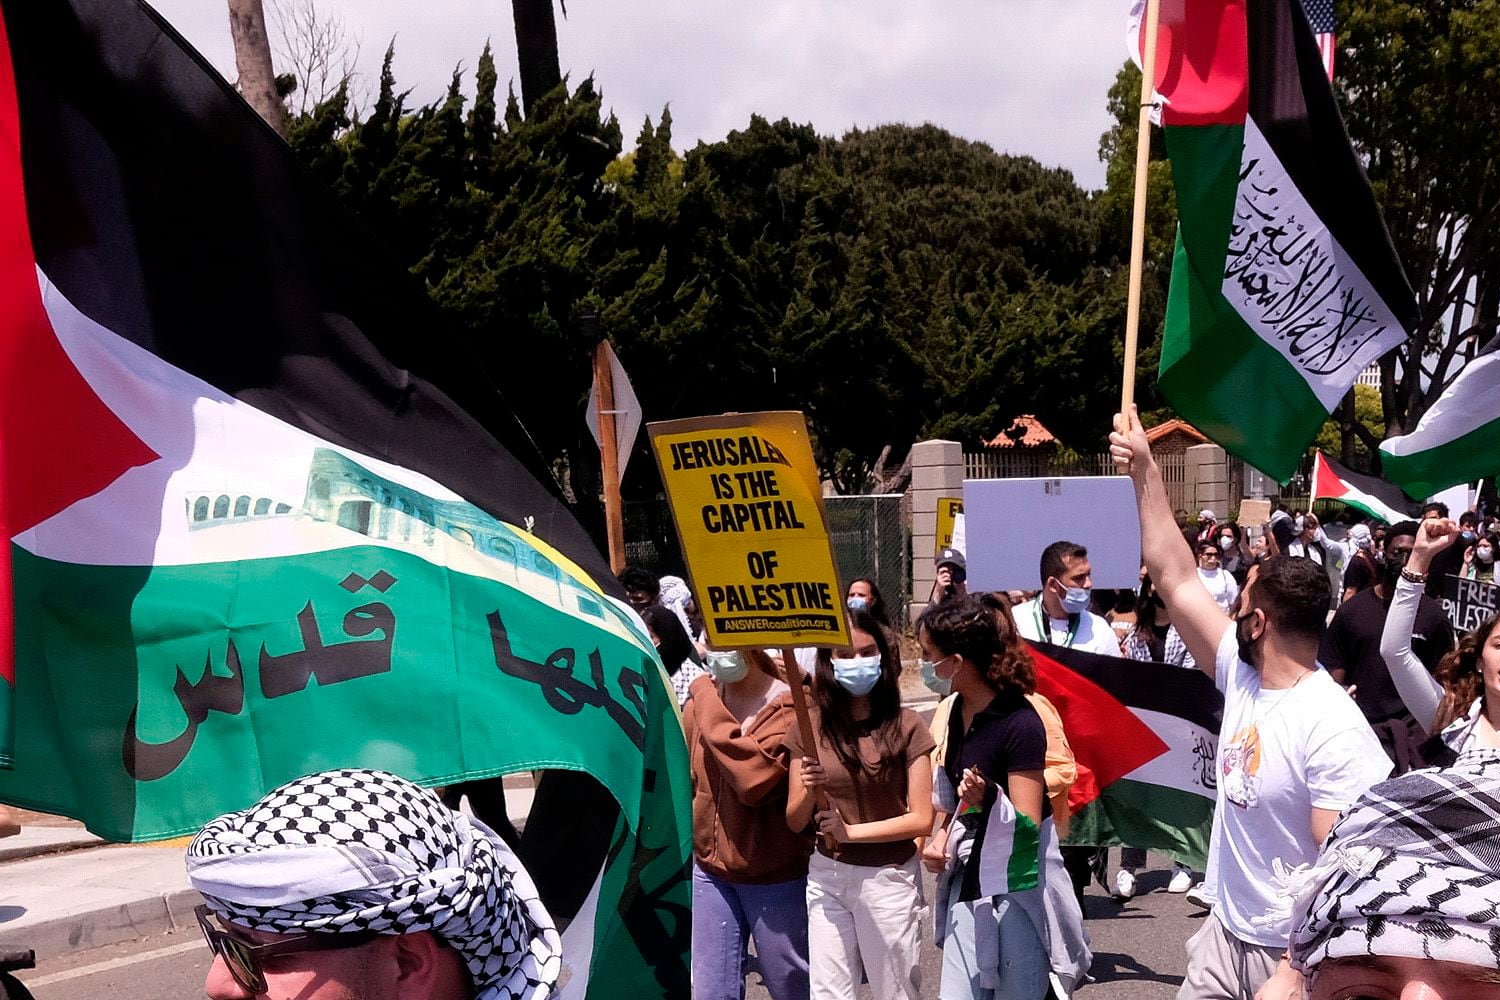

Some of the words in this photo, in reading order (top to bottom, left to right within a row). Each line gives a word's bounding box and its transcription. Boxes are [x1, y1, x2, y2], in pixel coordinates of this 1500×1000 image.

[710, 472, 735, 500] IS
[734, 470, 781, 500] THE
[702, 500, 806, 534] CAPITAL
[747, 550, 779, 580] OF
[706, 582, 835, 614] PALESTINE
[1458, 580, 1498, 609] FREE
[724, 618, 832, 632] ANSWERcoalition.org
[1442, 598, 1496, 632] PALEST
